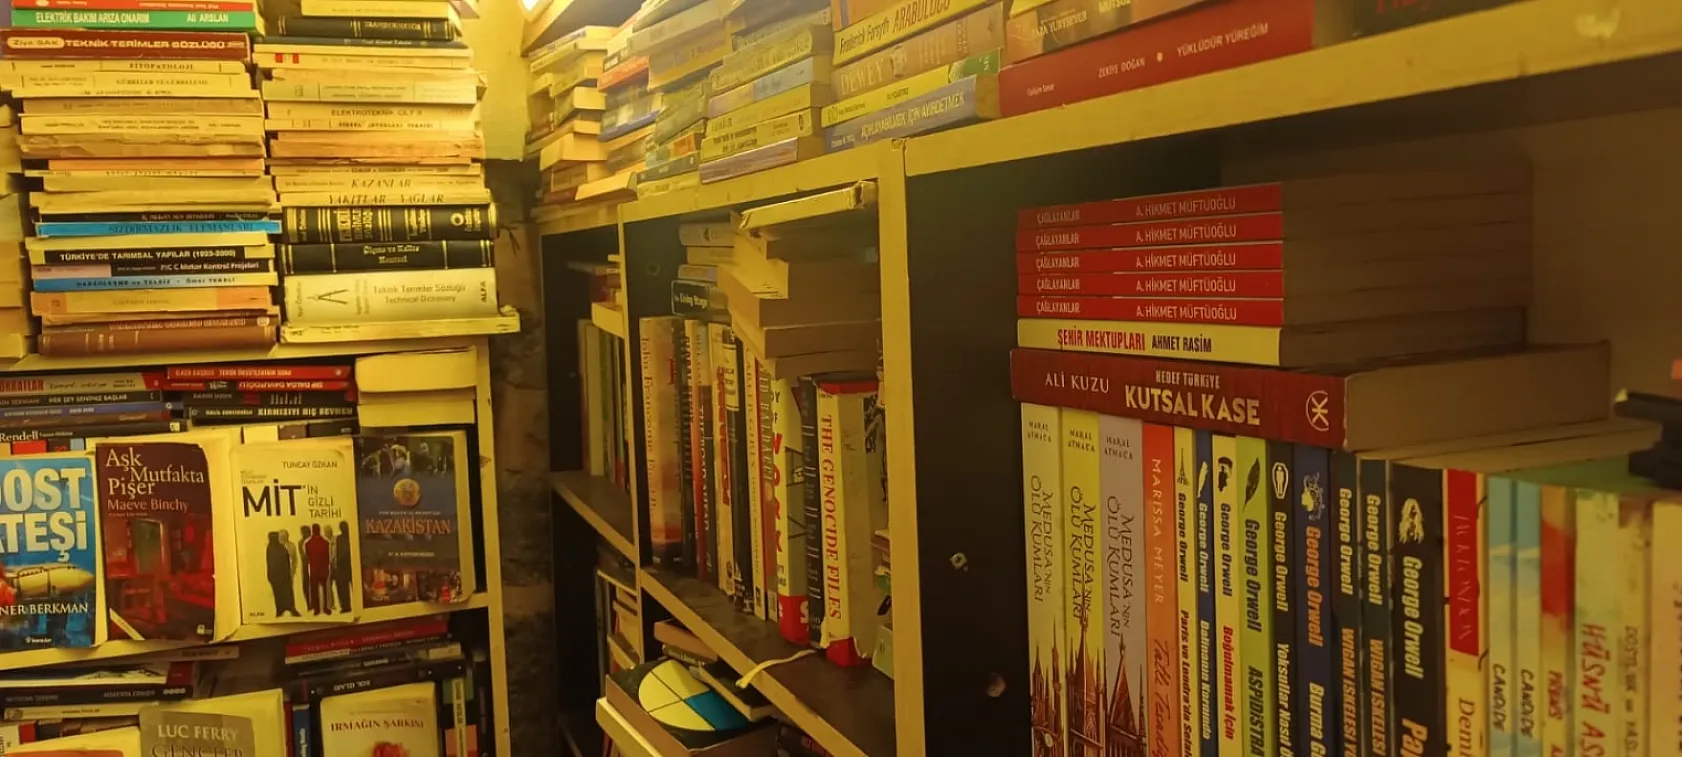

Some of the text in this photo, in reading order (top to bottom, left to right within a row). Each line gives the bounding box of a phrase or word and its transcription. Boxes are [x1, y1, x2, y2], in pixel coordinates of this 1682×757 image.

[65, 38, 108, 48] TEKNİK
[111, 39, 170, 49] TERİMLER
[1224, 22, 1269, 47] YÜREĞİM
[1120, 57, 1145, 74] DOĞAN
[1135, 196, 1236, 217] A. HİKMET MÜFTÜOĞLU
[1135, 223, 1237, 243] A. HİKMET MÜFTÜOĞLU
[1135, 250, 1236, 268] A. HİKMET MÜFTÜOĞLU
[1135, 274, 1236, 292] A. HİKMET MÜFTÜOĞLU
[1135, 300, 1237, 320] A. HİKMET MÜFTÜOĞLU
[1057, 325, 1212, 353] ŞEHİR MEKTUPLARI AHMET RASİM
[1045, 370, 1110, 394] ALİ KUZU
[1155, 369, 1220, 390] HEDEF TÜRKİYE
[1124, 386, 1261, 426] KUTSAL KASE
[0, 431, 39, 443] Rendell
[105, 447, 143, 471] Aşk
[282, 461, 312, 469] TUNCAY
[130, 464, 205, 484] Mutfakta
[0, 468, 86, 512] OST
[107, 477, 156, 499] Pişer
[308, 495, 334, 507] GİZLİ
[107, 498, 189, 513] Maeve Binchy
[309, 507, 342, 519] TARİHİ
[819, 414, 844, 621] THE GENOCIDE FILES
[1070, 485, 1083, 529] ÖLÜ
[365, 516, 451, 535] KAZAKİSTAN
[1030, 475, 1044, 602] ÖLÜ KUMLARI
[1151, 458, 1164, 604] MARISSA MEYER
[1178, 492, 1189, 583] George Orwell
[1198, 502, 1210, 594] George Orwell
[1220, 502, 1233, 597] George Orwell
[1338, 487, 1354, 596] George Orwell
[1365, 493, 1384, 606] George Orwell
[1106, 495, 1121, 637] ÖLÜ KUMLARI
[1273, 511, 1289, 612] George Orwell
[1244, 518, 1263, 633] George Orwell
[1304, 525, 1324, 648] George Orwell
[29, 602, 89, 615] BERKMAN
[1401, 555, 1425, 680] George Orwell
[1180, 609, 1190, 643] Paris
[1182, 644, 1190, 660] ve
[1341, 628, 1355, 677] WIGAN
[1369, 638, 1385, 690] WIGAN
[1223, 625, 1234, 712] Boğulmamak
[1277, 643, 1292, 746] Yoksullar Nasıl
[1309, 682, 1325, 739] Burma
[157, 724, 239, 742] LUC FERRY
[330, 719, 381, 732] IRMAĞIN
